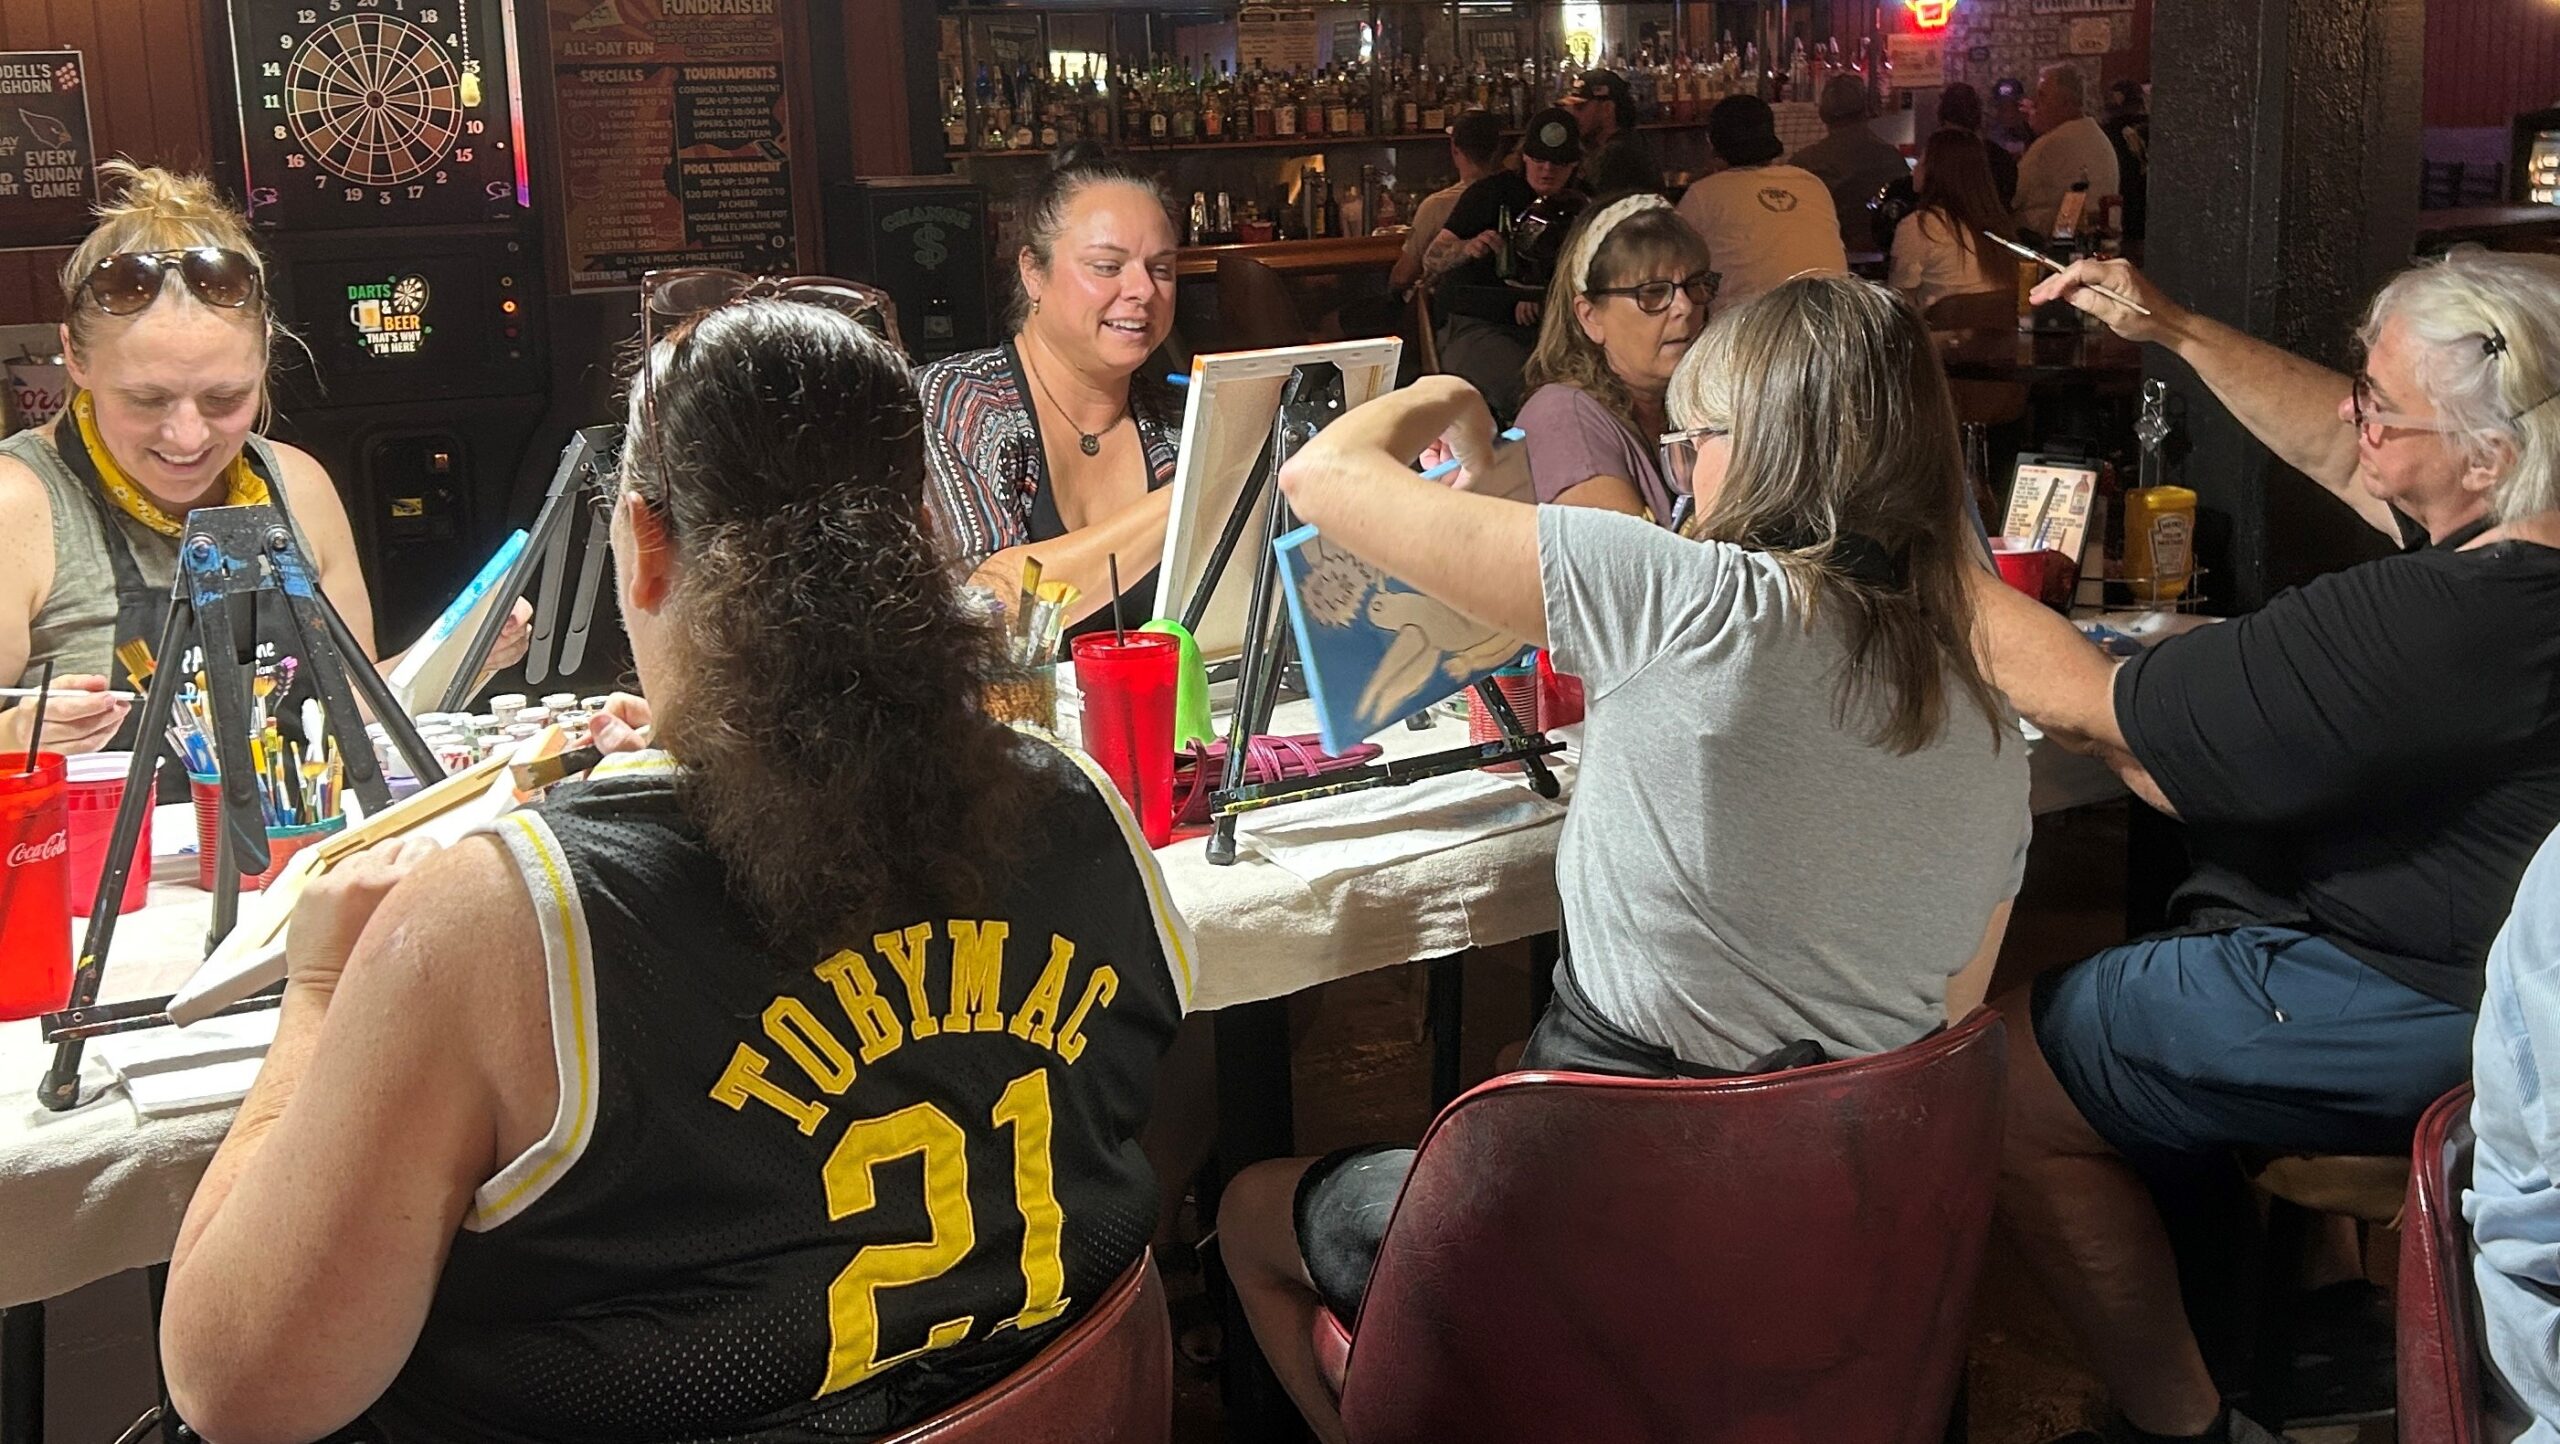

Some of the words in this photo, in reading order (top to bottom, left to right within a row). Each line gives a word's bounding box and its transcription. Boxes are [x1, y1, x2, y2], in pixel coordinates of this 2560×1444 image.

[661, 0, 775, 14] FUNDRAISER
[297, 10, 317, 24] 12
[419, 9, 438, 23] 18
[280, 35, 293, 50] 9
[446, 33, 458, 47] 4
[564, 42, 623, 56] ALL-DAY
[627, 41, 655, 55] FUN
[0, 64, 51, 79] DELL'S
[262, 63, 281, 77] 14
[580, 68, 644, 83] SPECIALS
[684, 66, 777, 80] TOURNAMENTS
[0, 79, 52, 94] GHORN
[678, 85, 723, 94] CORNHOLE
[726, 84, 780, 93] TOURNAMENT
[263, 95, 281, 109] 11
[753, 96, 766, 104] AM
[693, 108, 715, 116] BAGS
[758, 107, 770, 115] AM
[274, 126, 287, 140] 8
[466, 120, 484, 134] 10
[24, 149, 77, 166] EVERY
[286, 154, 306, 168] 16
[455, 148, 473, 162] 15
[23, 166, 84, 183] SUNDAY
[683, 163, 711, 175] POOL
[713, 162, 781, 174] TOURNAMENT
[315, 175, 327, 190] 7
[436, 171, 448, 184] 2
[757, 177, 769, 185] PM
[30, 182, 81, 199] GAME!
[345, 188, 363, 202] 19
[407, 186, 424, 199] 17
[751, 188, 773, 197] GOES
[775, 187, 786, 196] TO
[380, 192, 391, 205] 3
[601, 216, 622, 225] DOS
[624, 215, 652, 225] EQUIS
[688, 212, 716, 221] HOUSE
[717, 211, 754, 220] MATCHES
[756, 211, 770, 219] THE
[772, 210, 788, 219] POT
[600, 229, 630, 238] GREEN
[632, 227, 655, 236] TEAS
[696, 223, 728, 232] DOUBLE
[730, 222, 782, 231] ELIMINATION
[591, 240, 635, 250] WESTERN
[638, 239, 657, 248] SON
[710, 235, 730, 243] BALL
[732, 234, 741, 242] IN
[653, 254, 679, 263] MUSIC
[686, 253, 708, 261] PRIZE
[710, 251, 745, 260] RAFFLES
[347, 284, 392, 300] DARTS
[382, 300, 392, 314] &
[384, 314, 421, 331] BEER
[366, 332, 398, 344] THAT'S
[400, 330, 421, 342] WHY
[374, 343, 390, 354] I'M
[390, 342, 416, 353] HERE
[708, 919, 1120, 1136] TOBYMAC
[811, 1067, 1072, 1401] 21
